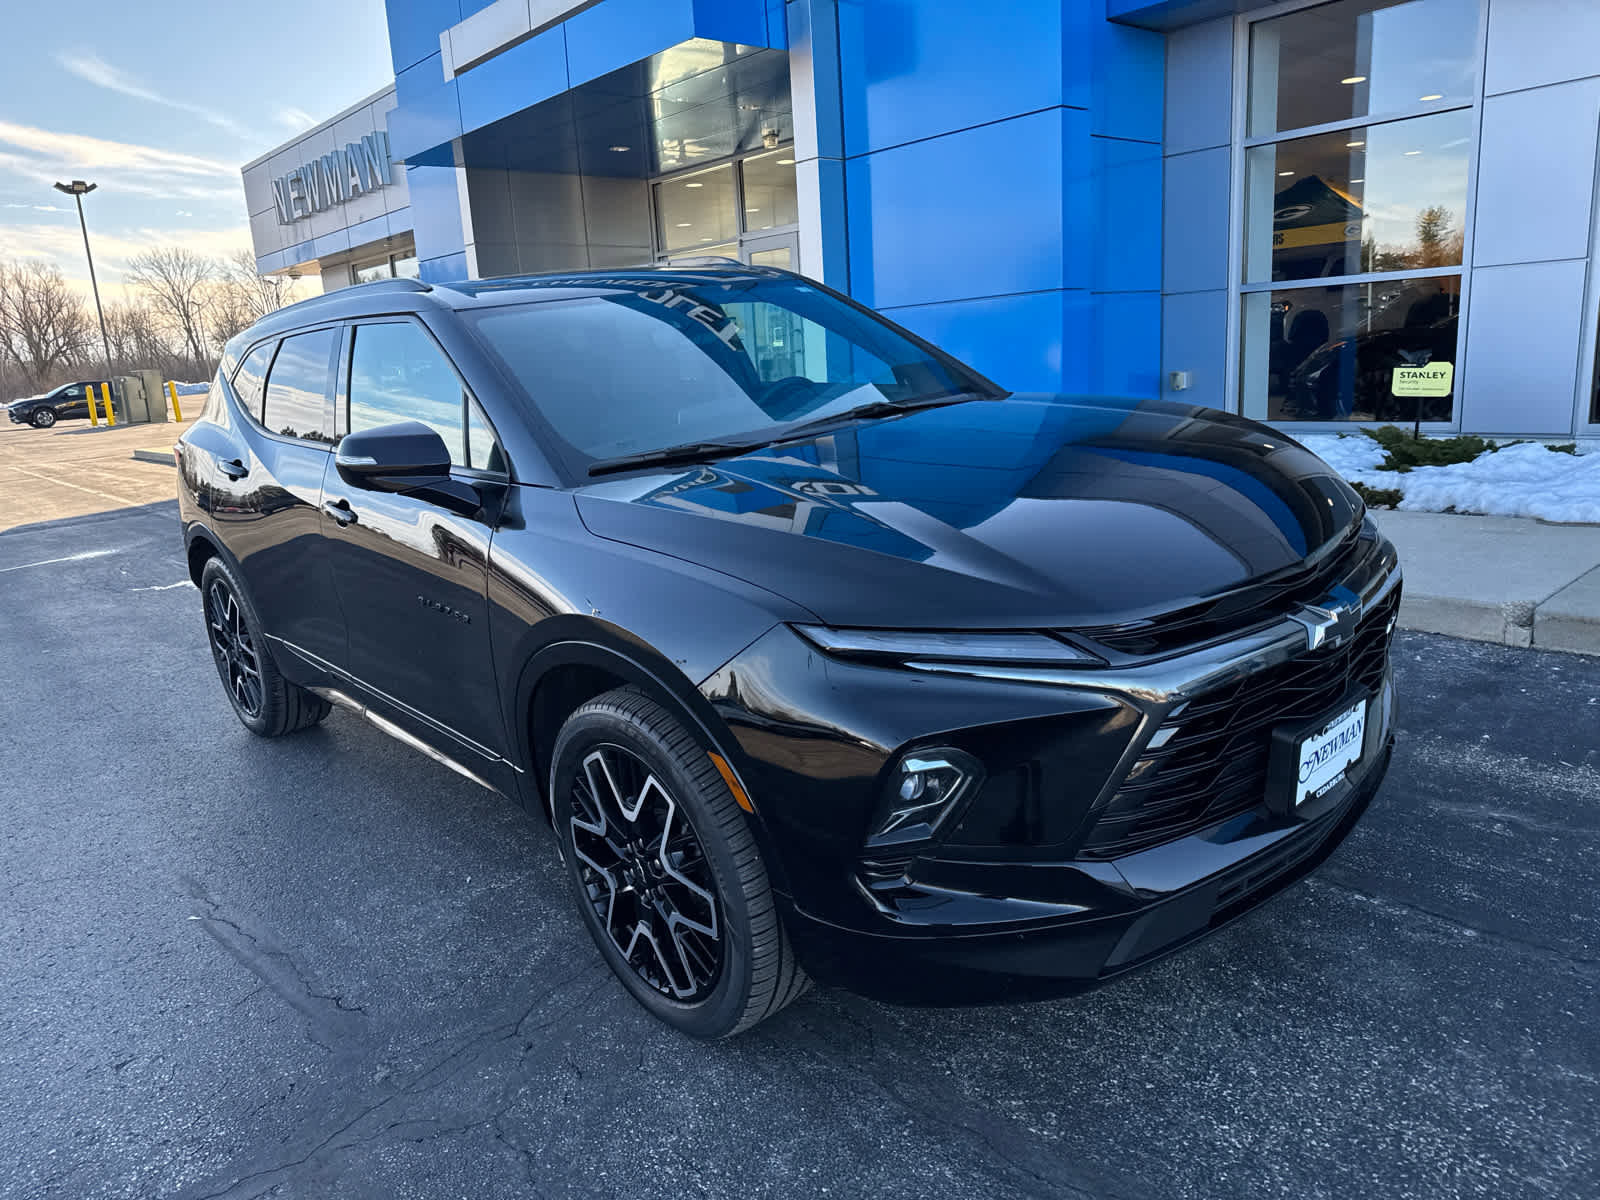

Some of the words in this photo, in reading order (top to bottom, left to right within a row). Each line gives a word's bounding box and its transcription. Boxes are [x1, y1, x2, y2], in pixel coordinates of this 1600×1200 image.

[271, 131, 391, 225] NEWMAN
[1400, 371, 1447, 379] STANLEY
[1298, 716, 1363, 784] NEWMAN
